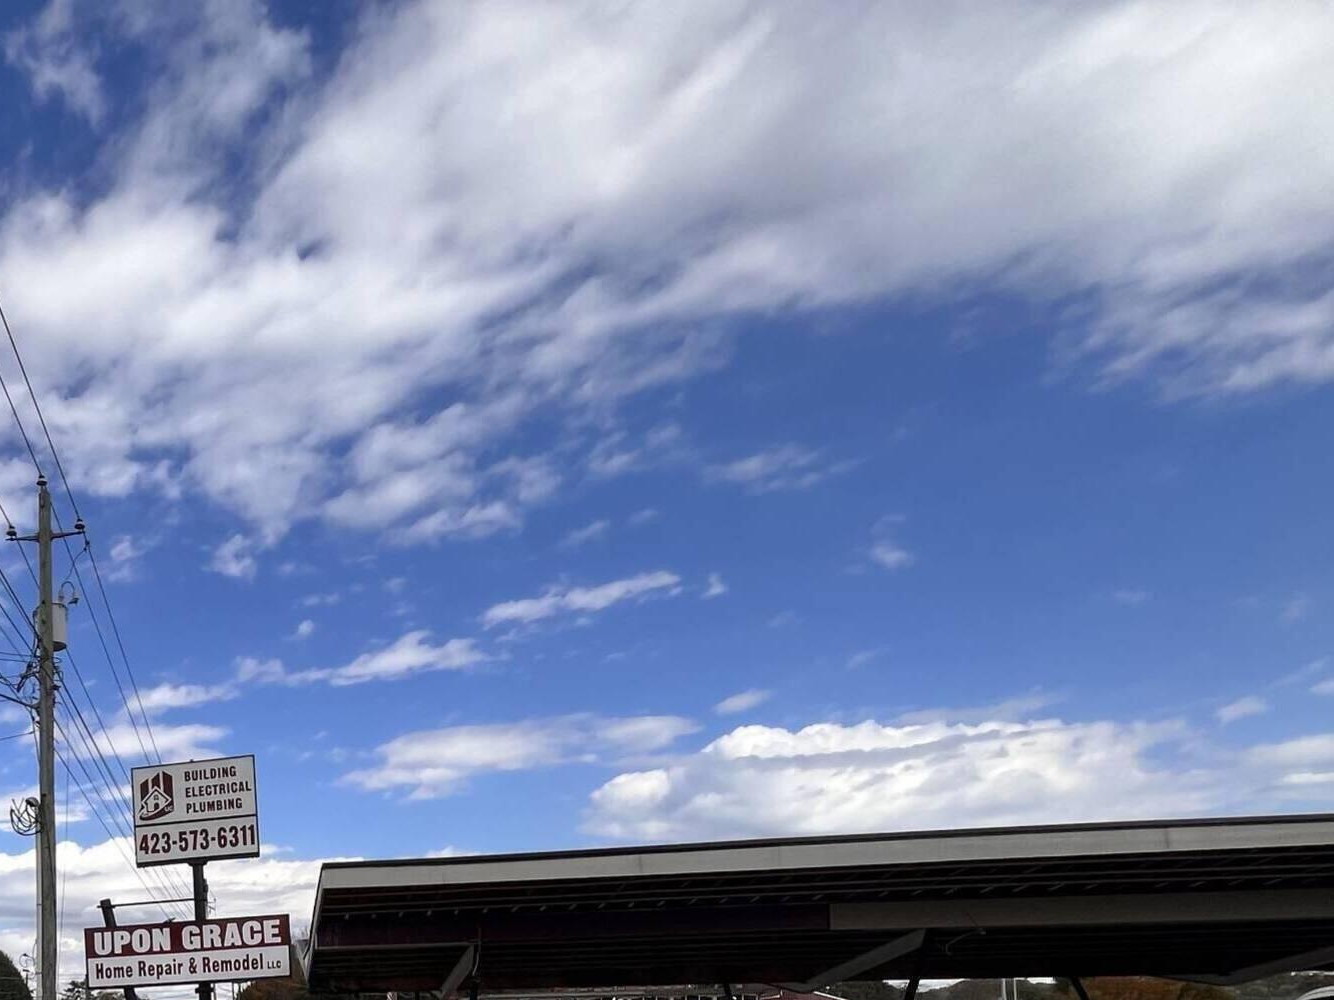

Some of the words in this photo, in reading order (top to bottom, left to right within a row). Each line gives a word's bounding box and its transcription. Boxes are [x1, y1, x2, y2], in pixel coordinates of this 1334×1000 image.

[184, 766, 237, 782] BUILDING
[185, 781, 252, 797] ELECTRICAL
[186, 798, 243, 814] PLUMBING
[139, 824, 256, 855] 423-573-6311
[93, 927, 171, 956] UPON
[181, 919, 282, 950] GRACE
[96, 962, 133, 979] Home
[138, 959, 184, 980] Repair
[188, 957, 198, 974] &
[202, 953, 264, 974] Remodel
[267, 960, 282, 969] LLC
